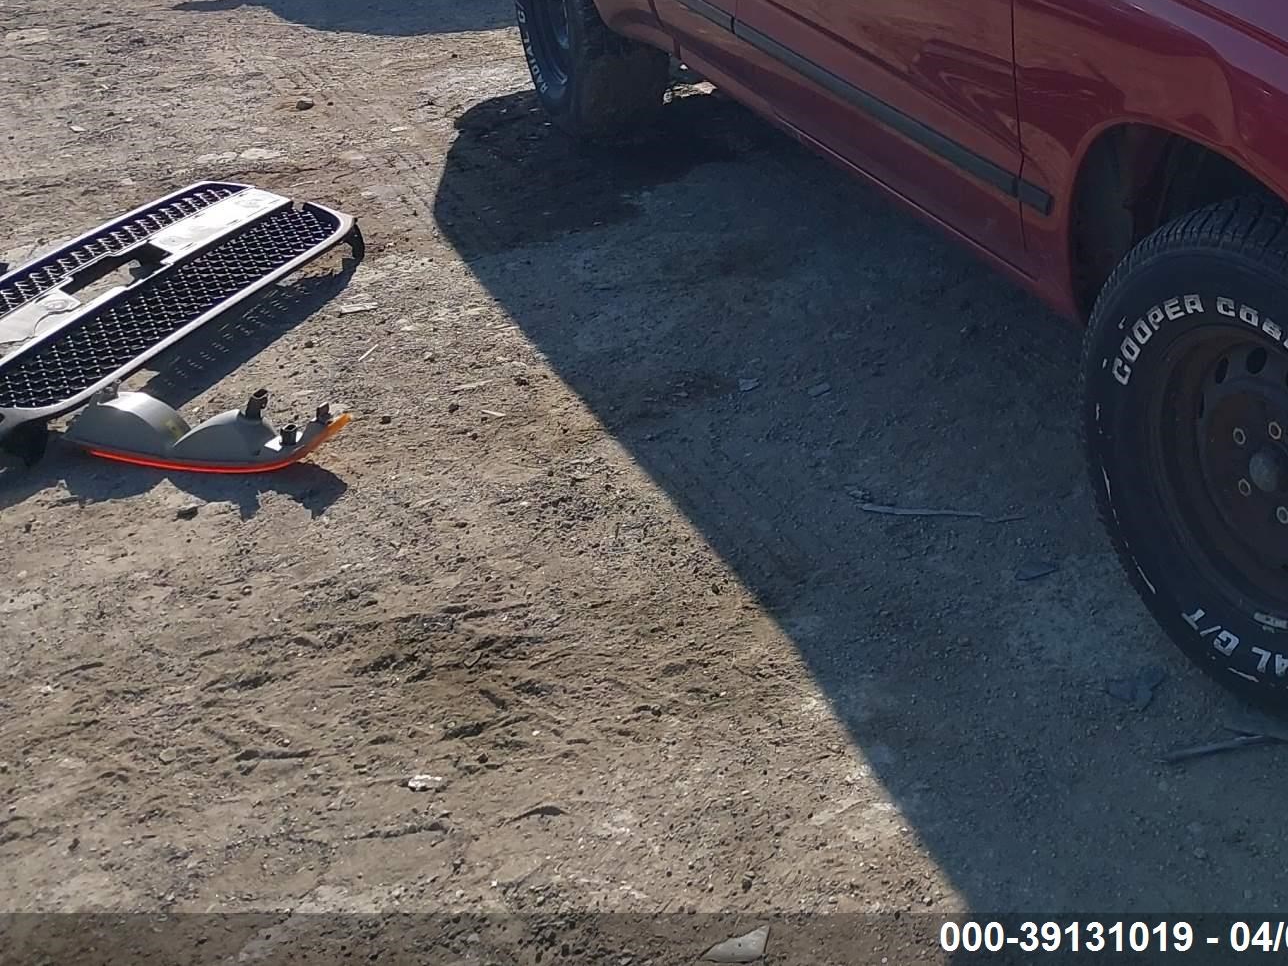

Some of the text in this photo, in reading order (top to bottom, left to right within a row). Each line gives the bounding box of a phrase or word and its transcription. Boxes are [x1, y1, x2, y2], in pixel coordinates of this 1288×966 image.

[522, 30, 549, 96] RADIAL
[1111, 293, 1205, 386] COOPER
[1180, 608, 1240, 657] G/T
